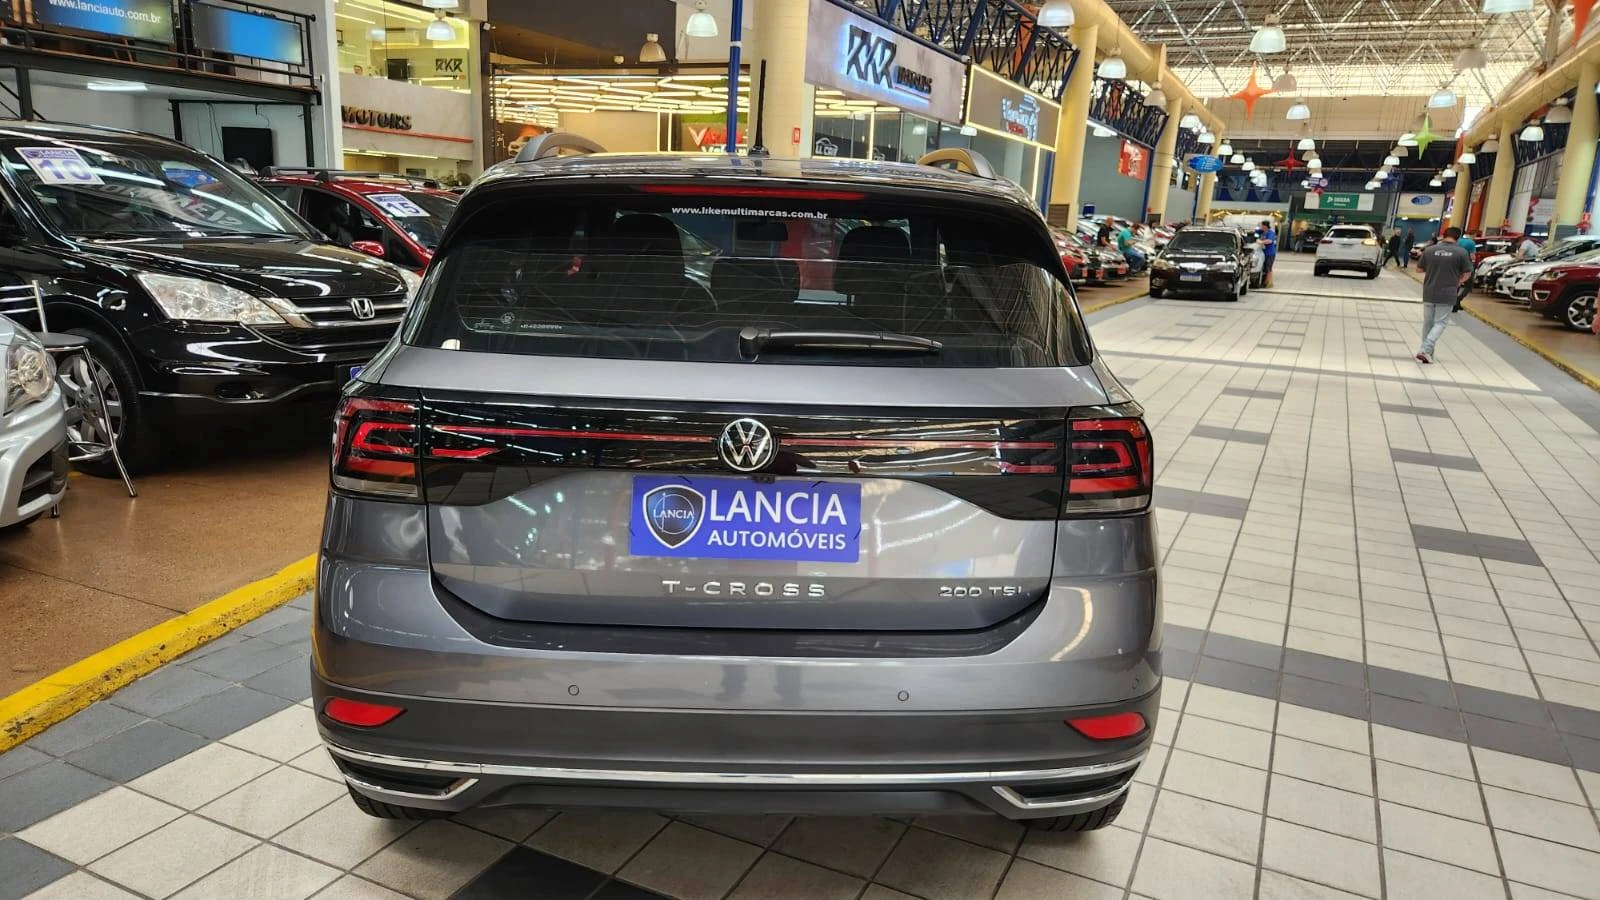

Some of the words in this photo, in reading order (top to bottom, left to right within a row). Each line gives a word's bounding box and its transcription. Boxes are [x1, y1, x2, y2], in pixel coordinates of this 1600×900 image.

[48, 0, 160, 23] www.lanciauto.com.br
[846, 24, 897, 89] RKR
[435, 58, 463, 73] RKR
[341, 105, 412, 130] MOTORS
[387, 203, 420, 214] 15
[672, 207, 828, 219] www.likemultimarcas.com.br
[653, 508, 694, 519] LANCIA
[710, 489, 847, 526] LANCIA
[707, 528, 846, 550] AUTOMÓVEIS
[662, 580, 825, 597] T-CROSS
[939, 586, 982, 597] 200
[988, 585, 1022, 597] TSI
